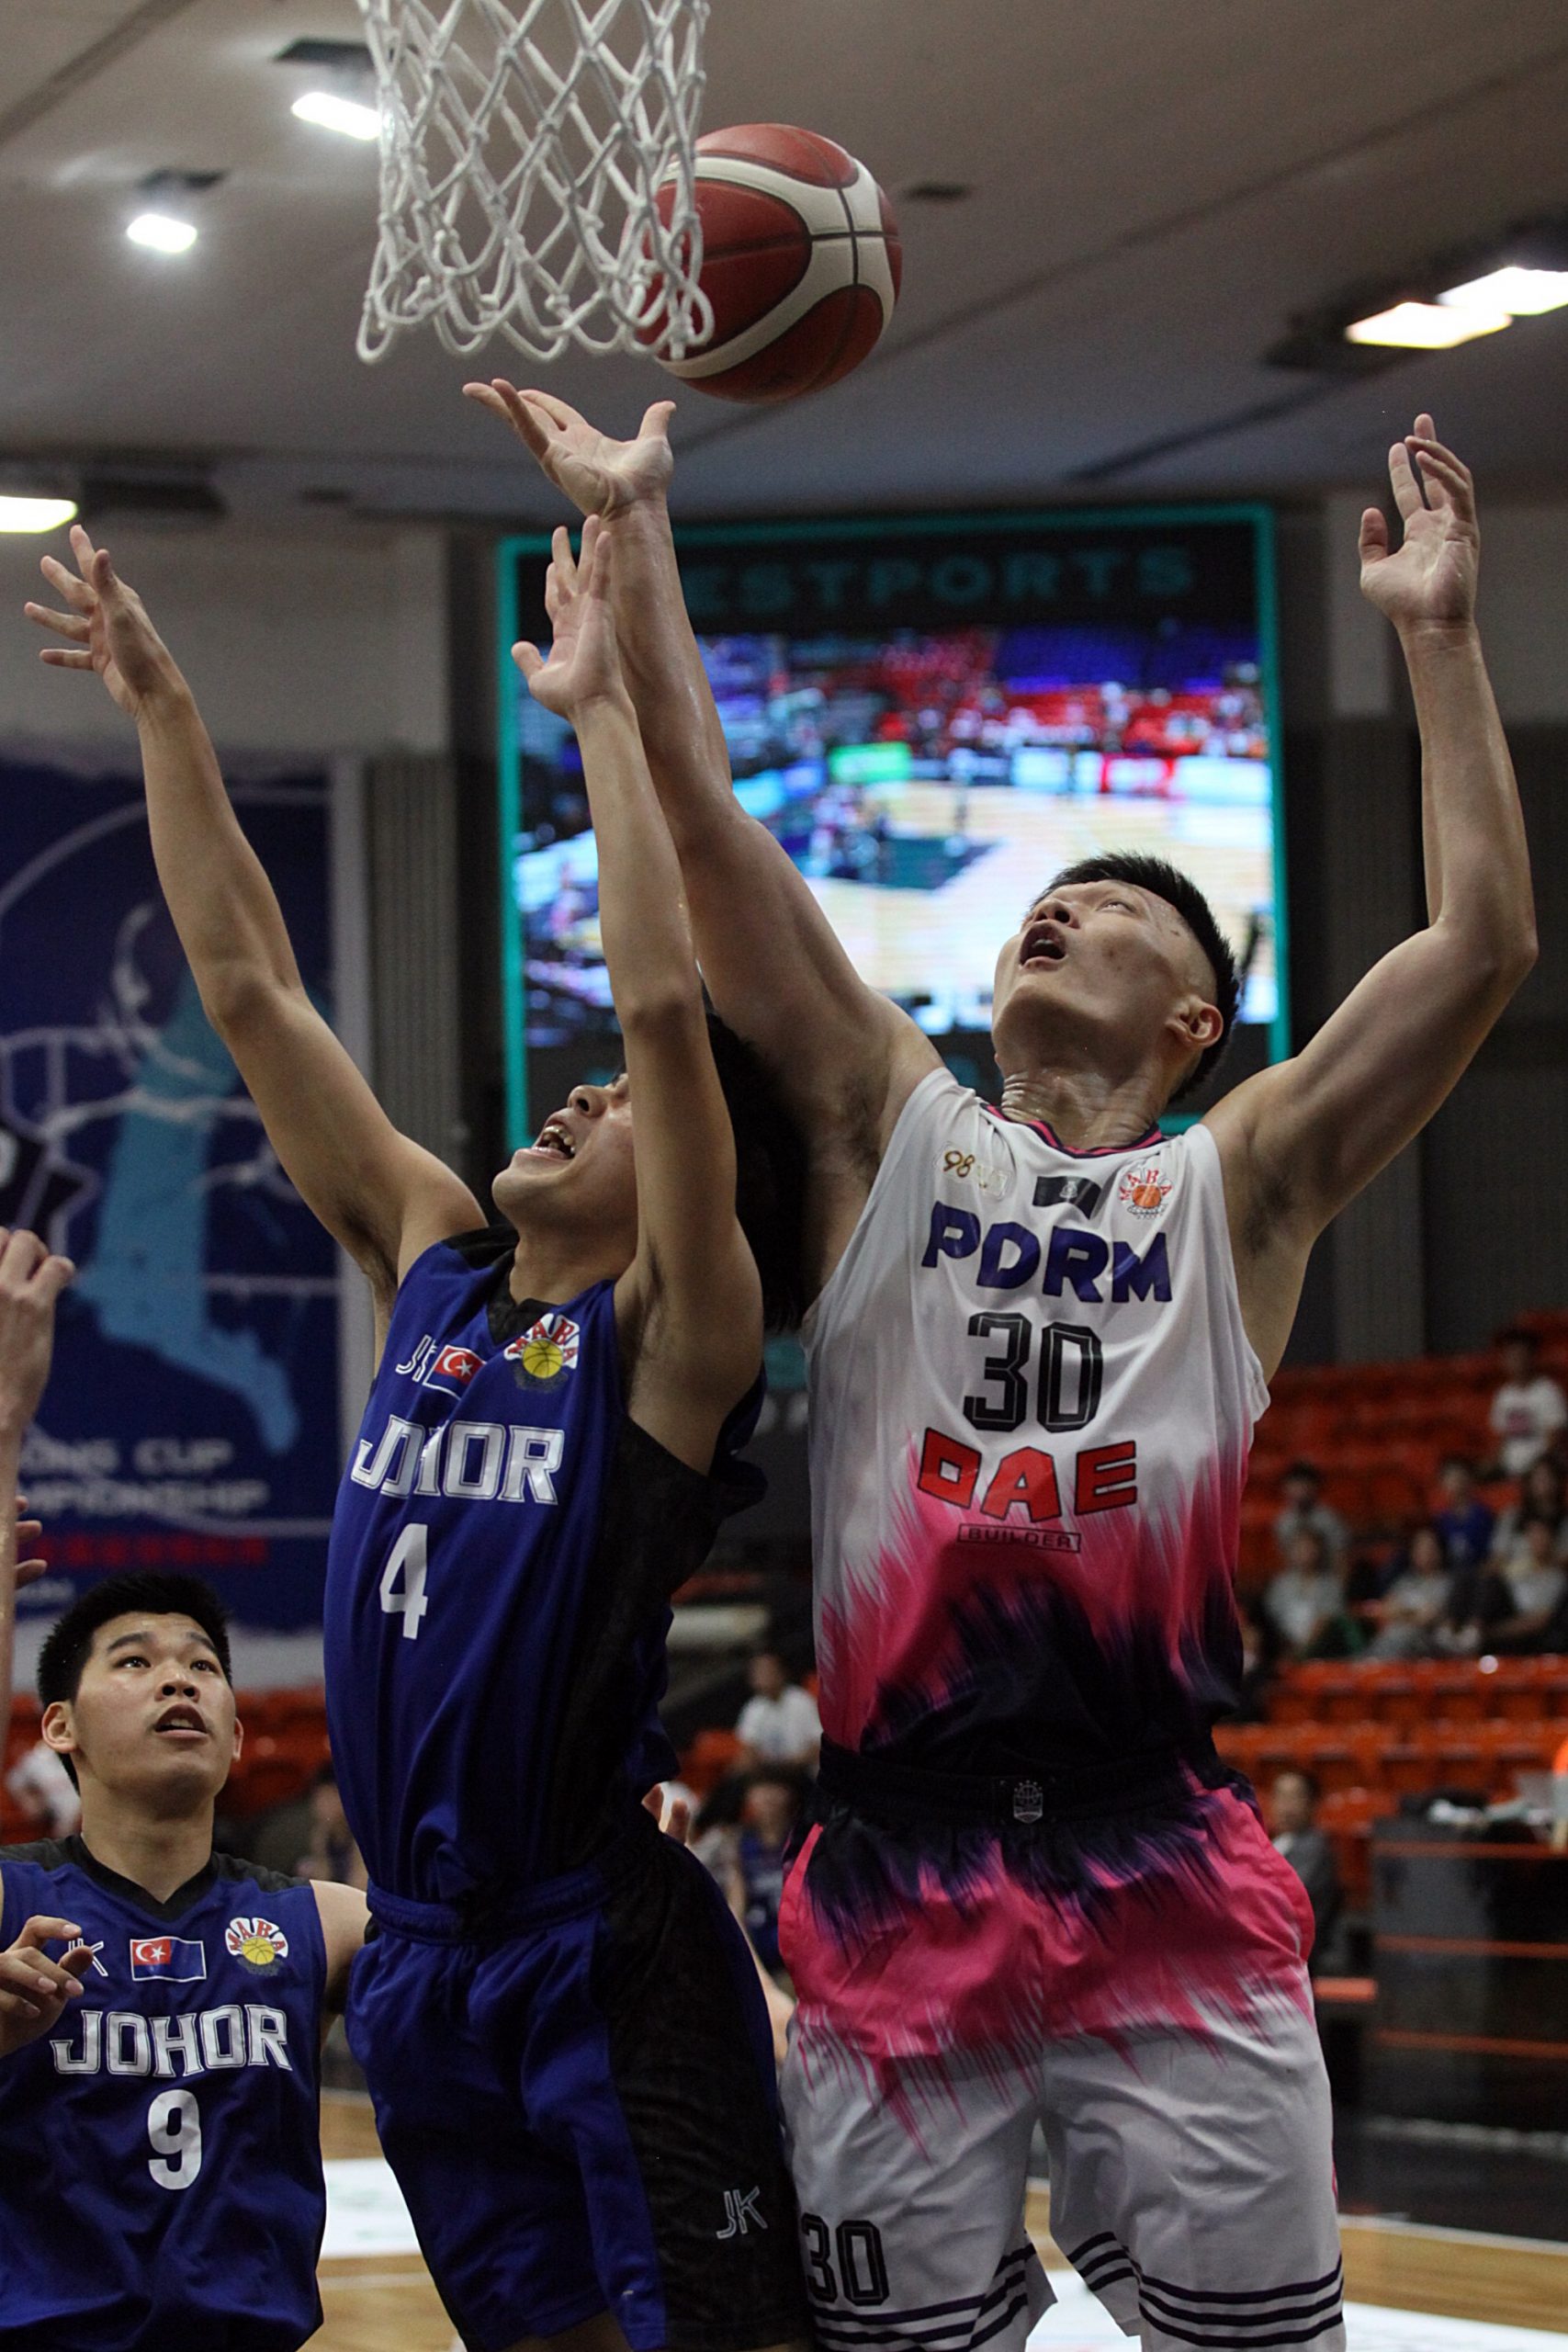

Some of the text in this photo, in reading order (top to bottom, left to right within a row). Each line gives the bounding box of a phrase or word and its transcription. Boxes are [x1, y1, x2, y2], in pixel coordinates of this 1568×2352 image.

[921, 1200, 1172, 1303] PDRM
[963, 1311, 1103, 1434] 30
[379, 1522, 428, 1640] 4
[968, 1527, 1072, 1549] BUILDER
[227, 1919, 287, 1951] MABA
[49, 2004, 293, 2078] JOHOR
[147, 2089, 202, 2190] 9
[716, 2185, 768, 2240] JK
[801, 2212, 890, 2306] 30
